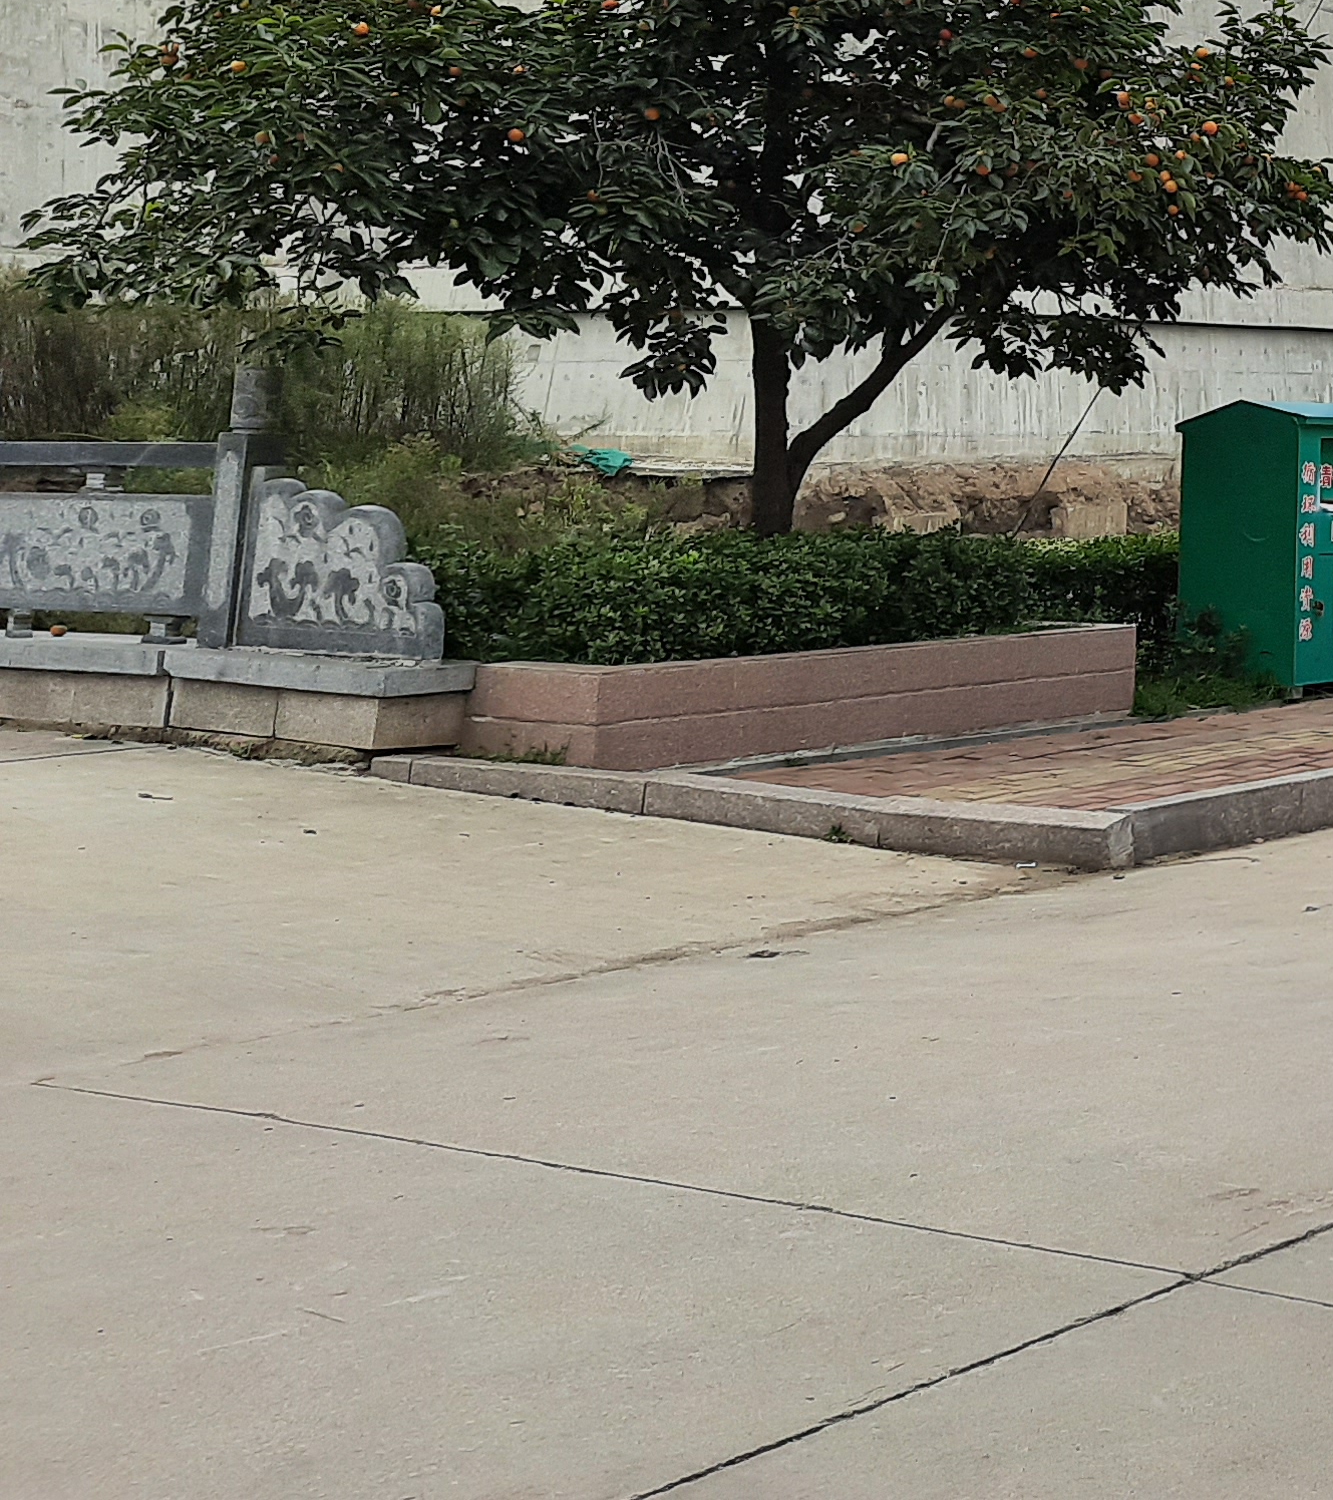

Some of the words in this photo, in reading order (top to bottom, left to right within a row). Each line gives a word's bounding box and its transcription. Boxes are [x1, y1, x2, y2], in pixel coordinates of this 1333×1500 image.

[1299, 460, 1316, 642] 循环利用资源
